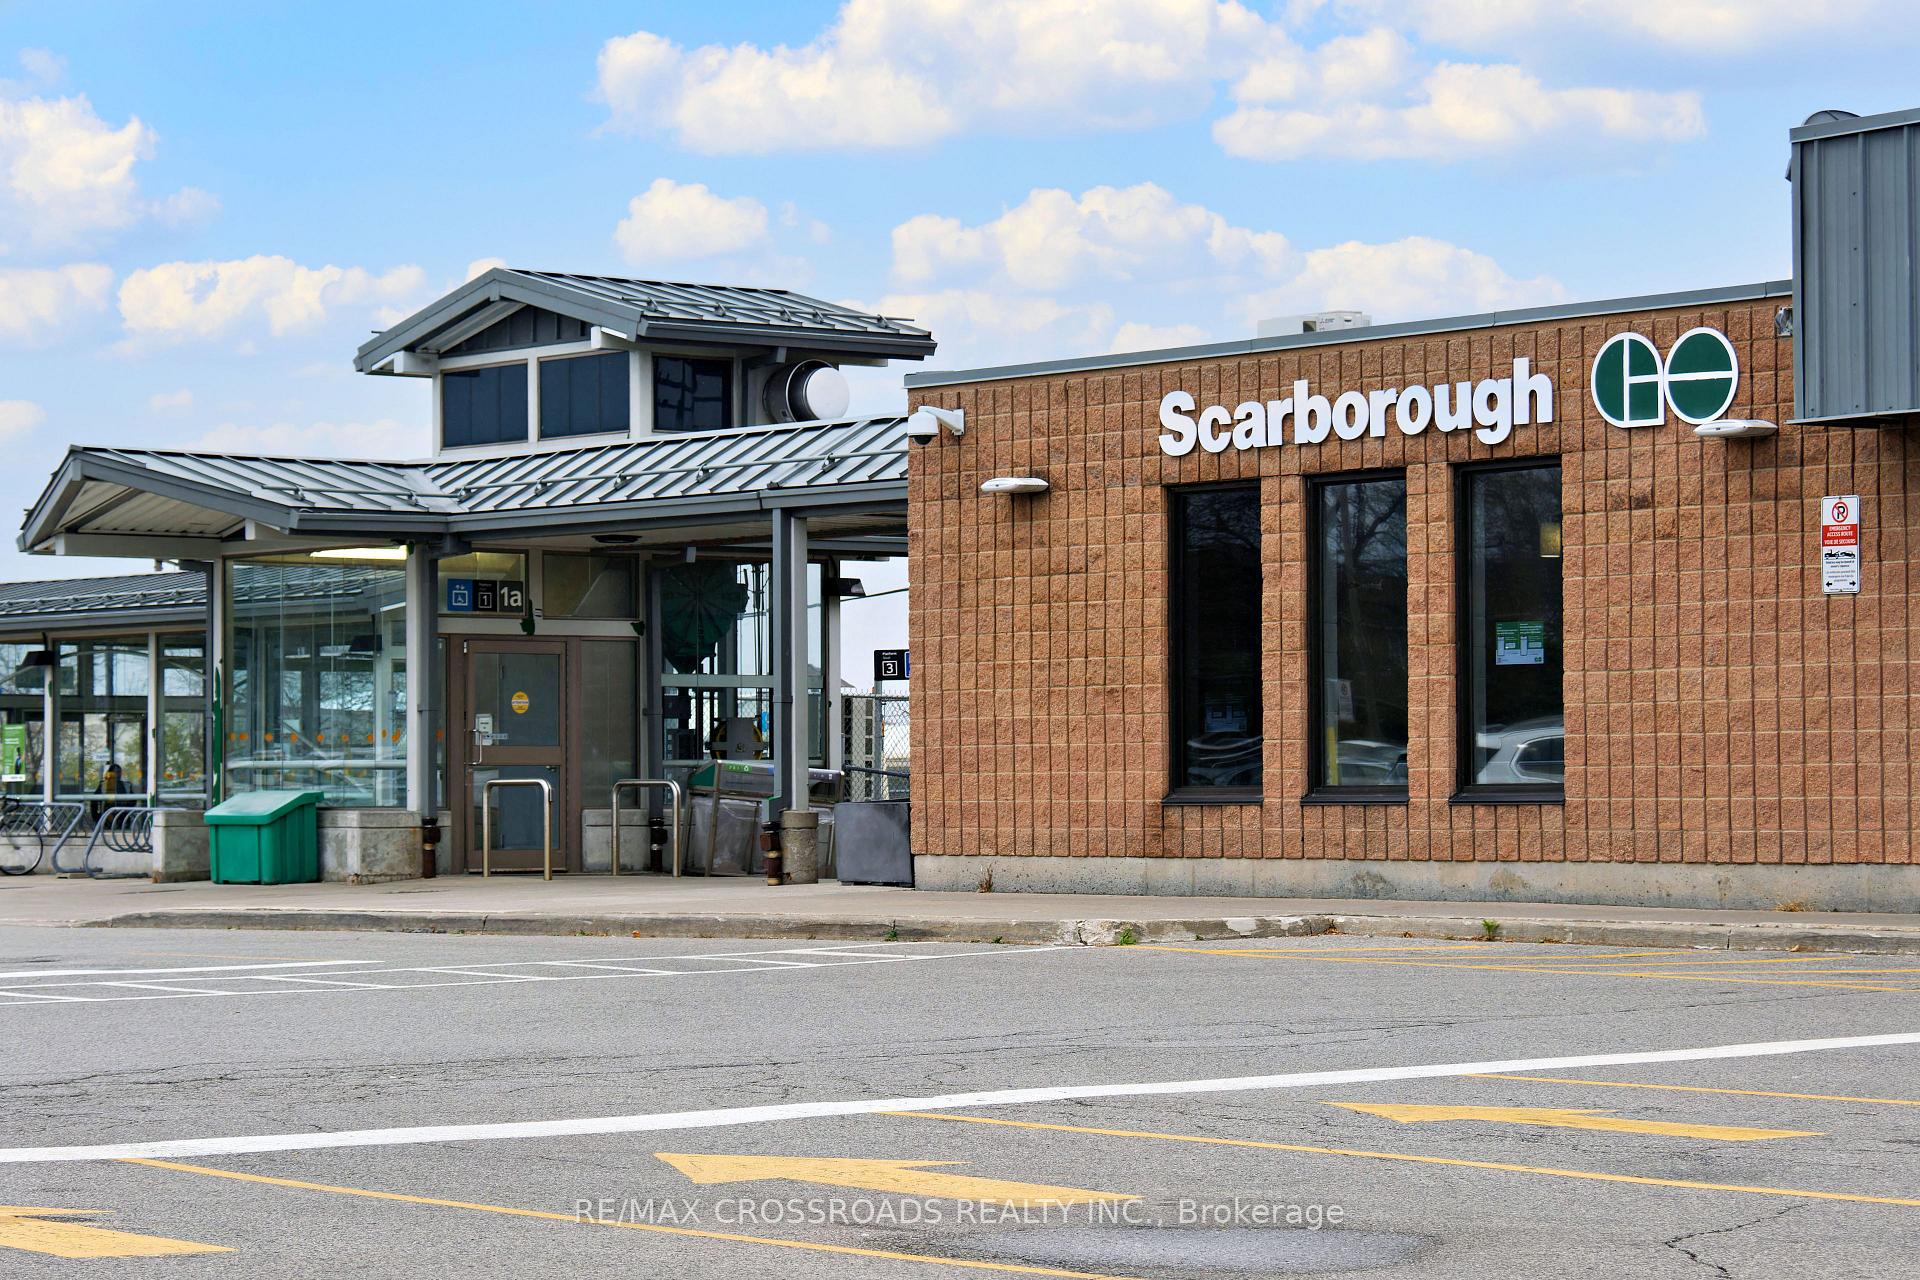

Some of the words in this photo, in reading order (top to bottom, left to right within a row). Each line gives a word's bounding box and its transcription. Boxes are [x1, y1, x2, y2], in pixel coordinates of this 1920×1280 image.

[1158, 356, 1554, 457] Scarborough
[482, 595, 488, 605] 1
[500, 586, 522, 607] 1a
[886, 663, 894, 674] 3
